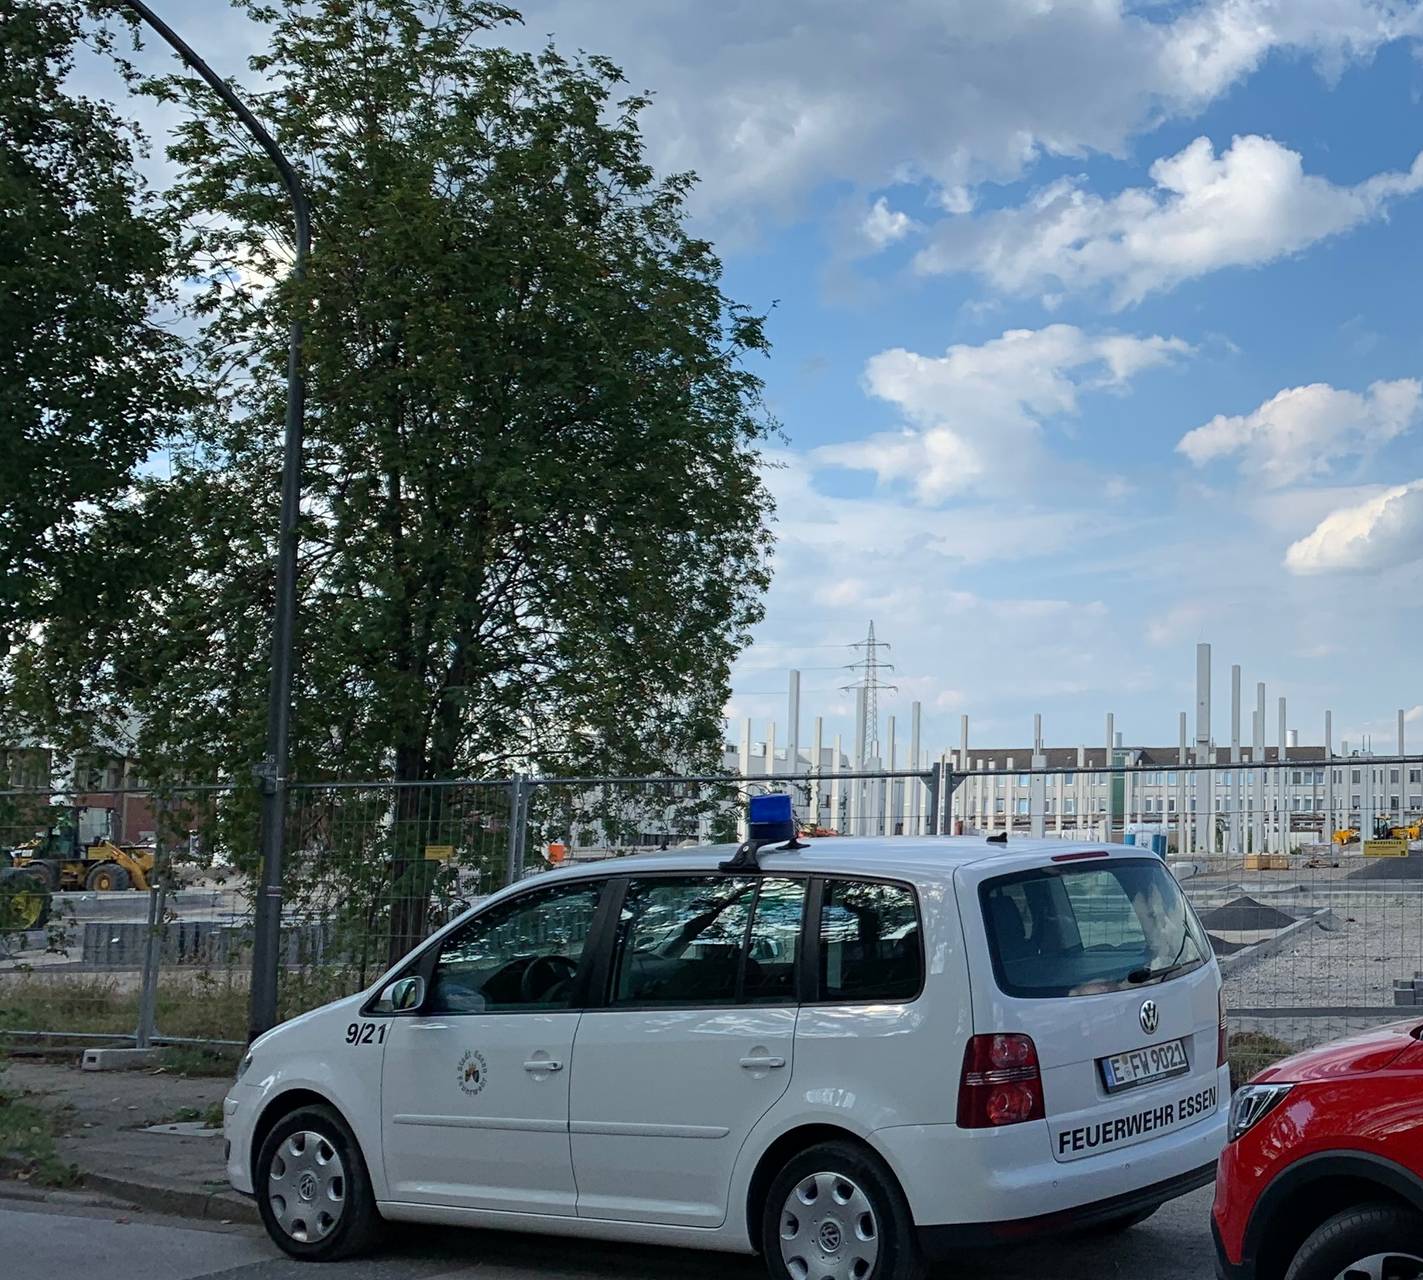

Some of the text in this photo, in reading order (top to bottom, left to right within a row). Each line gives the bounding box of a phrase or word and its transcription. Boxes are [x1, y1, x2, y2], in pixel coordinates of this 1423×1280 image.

[345, 1022, 387, 1046] 9/21
[1151, 1043, 1186, 1072] 9021
[1058, 1086, 1216, 1153] FEUERWEHR ESSEN
